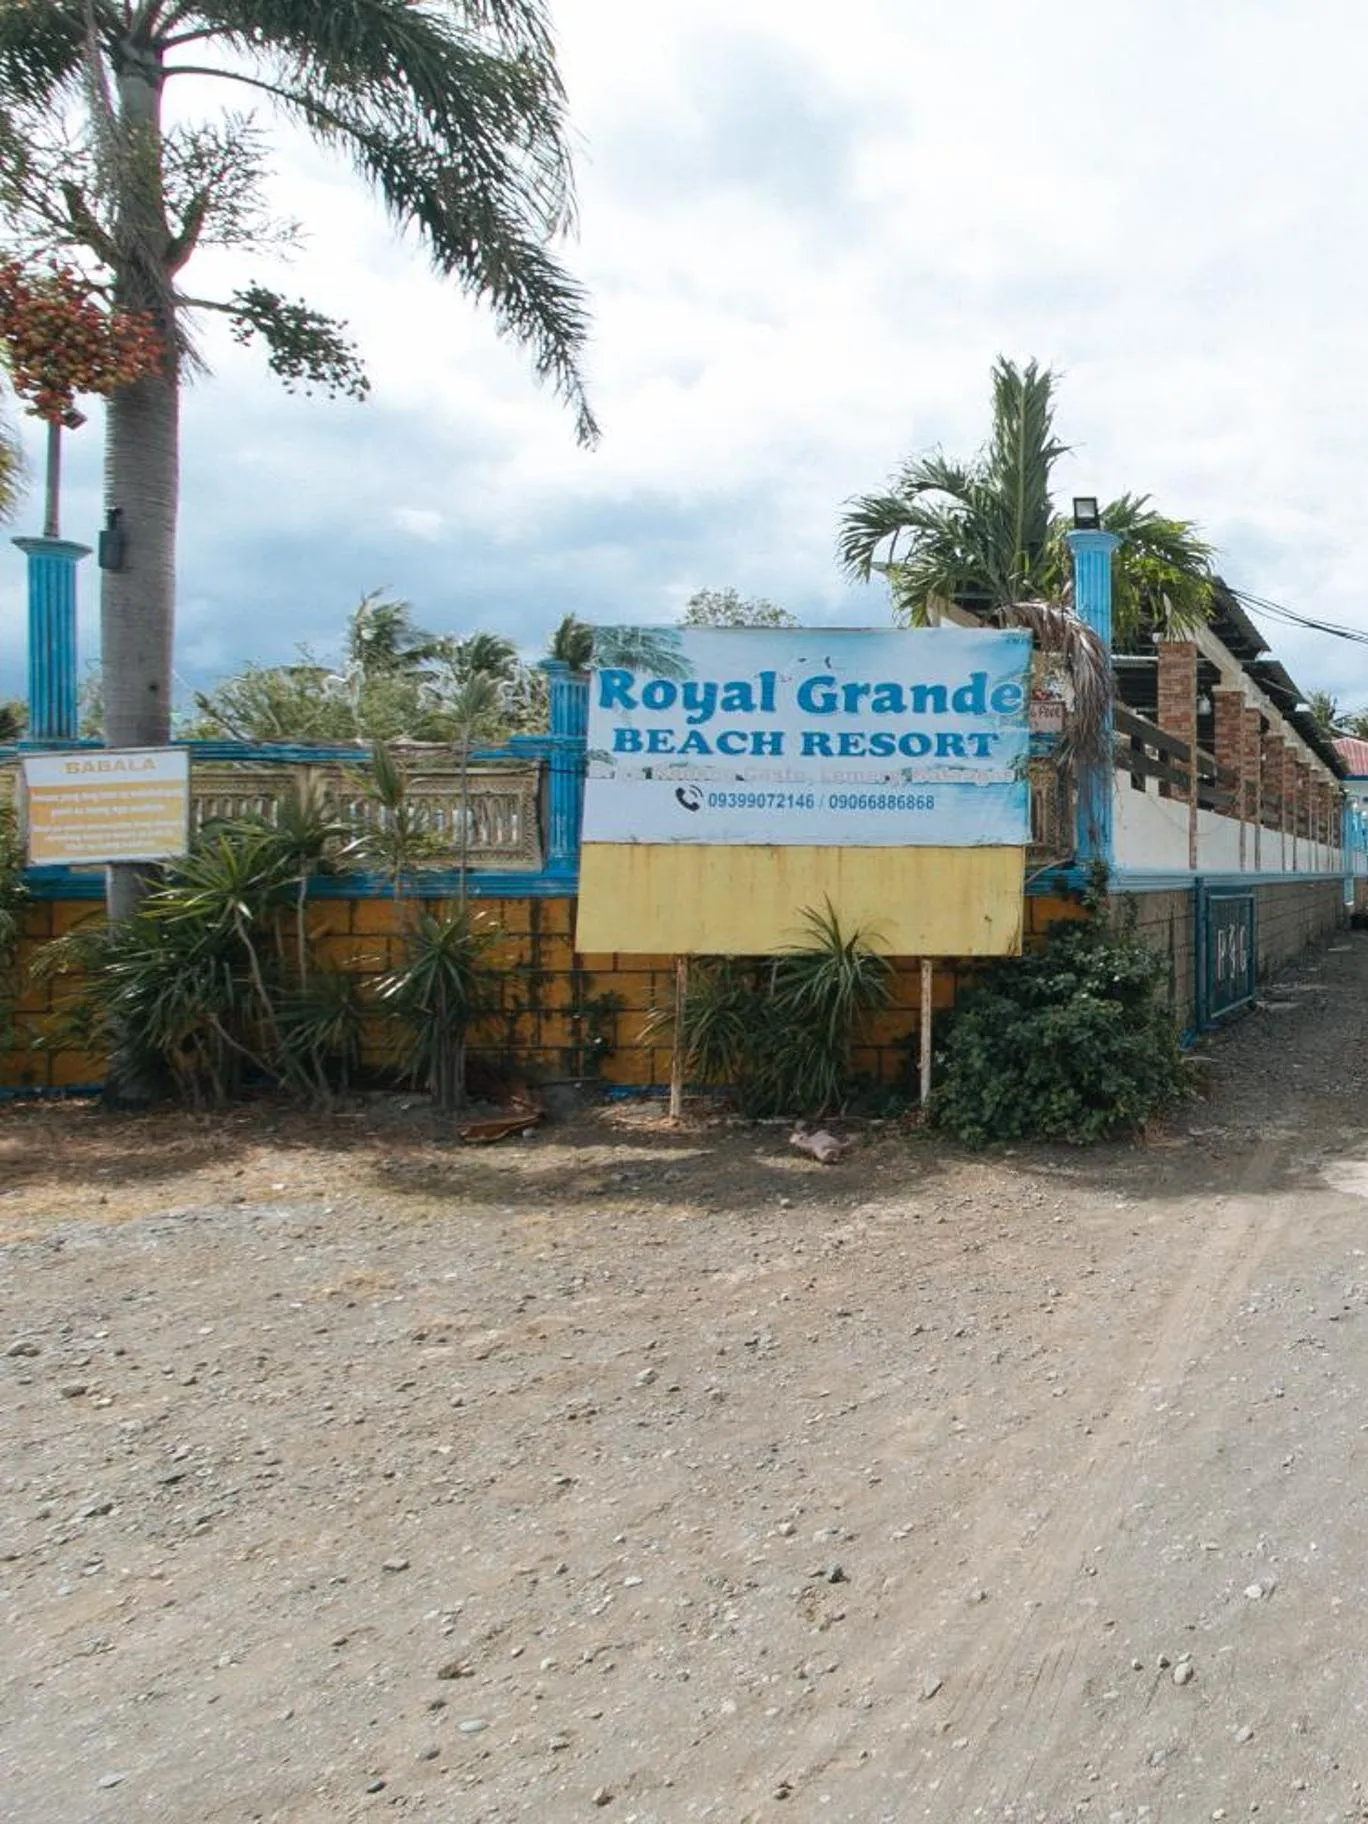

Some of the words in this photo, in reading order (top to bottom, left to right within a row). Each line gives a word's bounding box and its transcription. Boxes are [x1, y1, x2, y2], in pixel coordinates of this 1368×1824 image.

[597, 668, 777, 725] Royal
[797, 671, 1024, 716] Grande
[612, 729, 784, 755] BEACH
[802, 732, 998, 757] RESORT
[65, 758, 157, 774] BABALA
[708, 793, 815, 809] 09399072146
[829, 794, 935, 810] 09066886868
